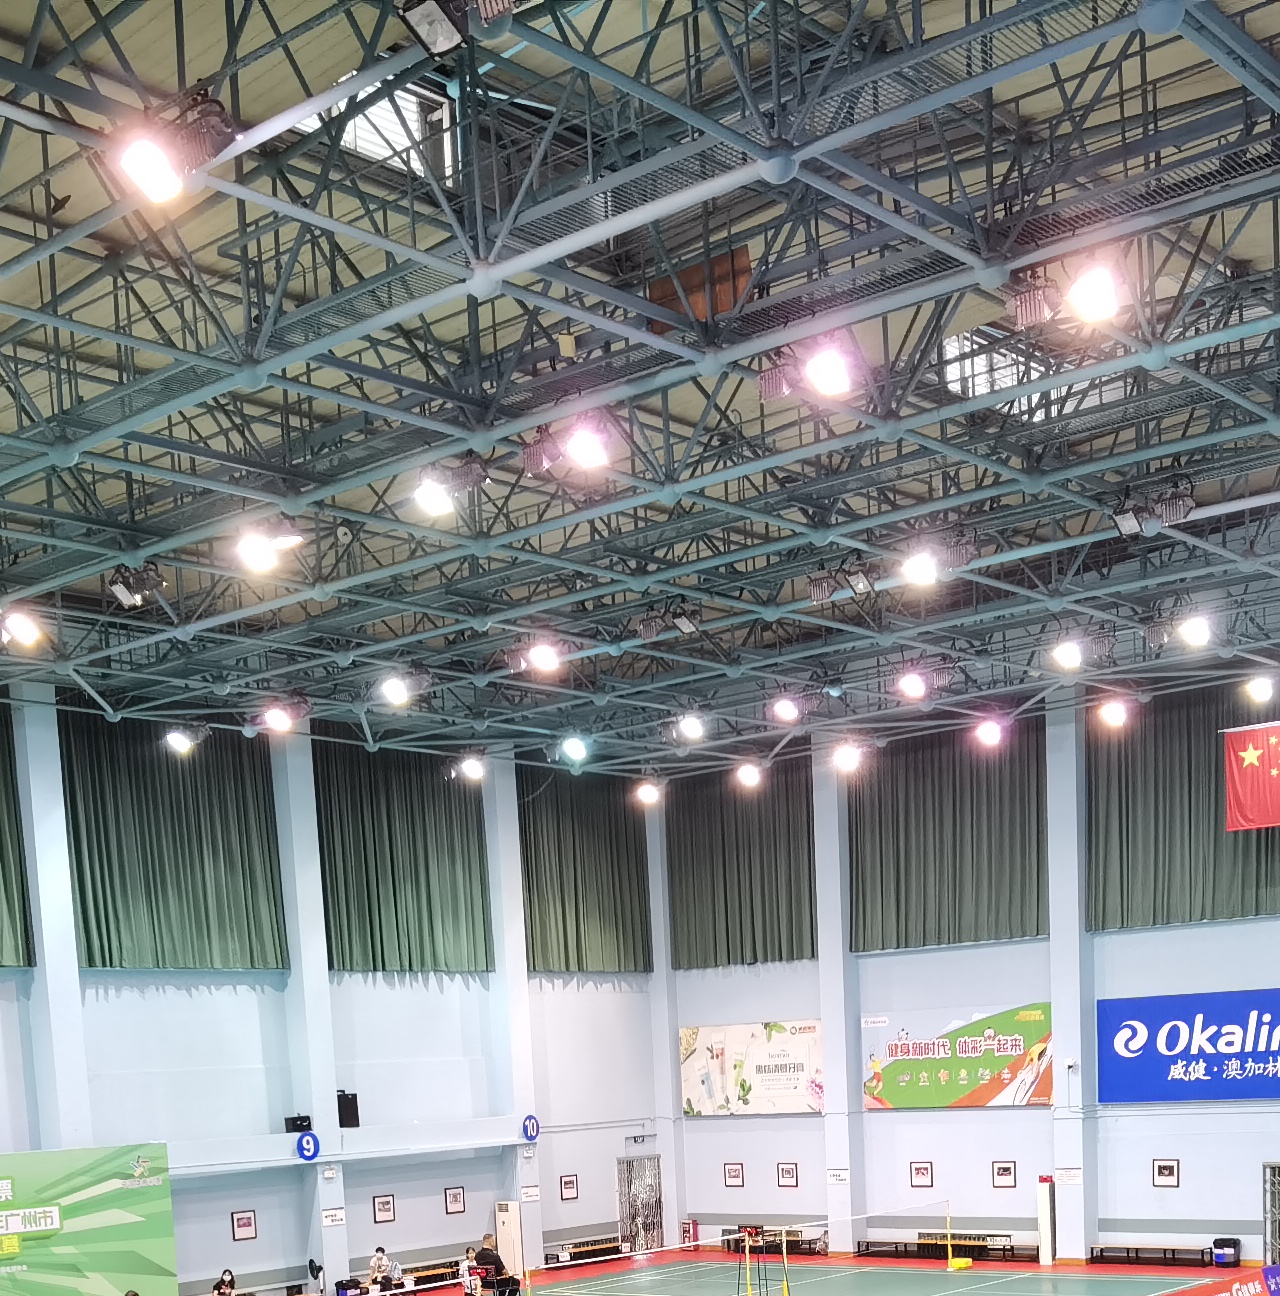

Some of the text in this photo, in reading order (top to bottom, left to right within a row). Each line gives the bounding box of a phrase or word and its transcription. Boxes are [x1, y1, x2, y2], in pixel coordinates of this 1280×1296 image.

[887, 1034, 1023, 1059] 健身新时代 体彩一起来
[525, 1119, 537, 1136] 10
[302, 1136, 315, 1157] 9
